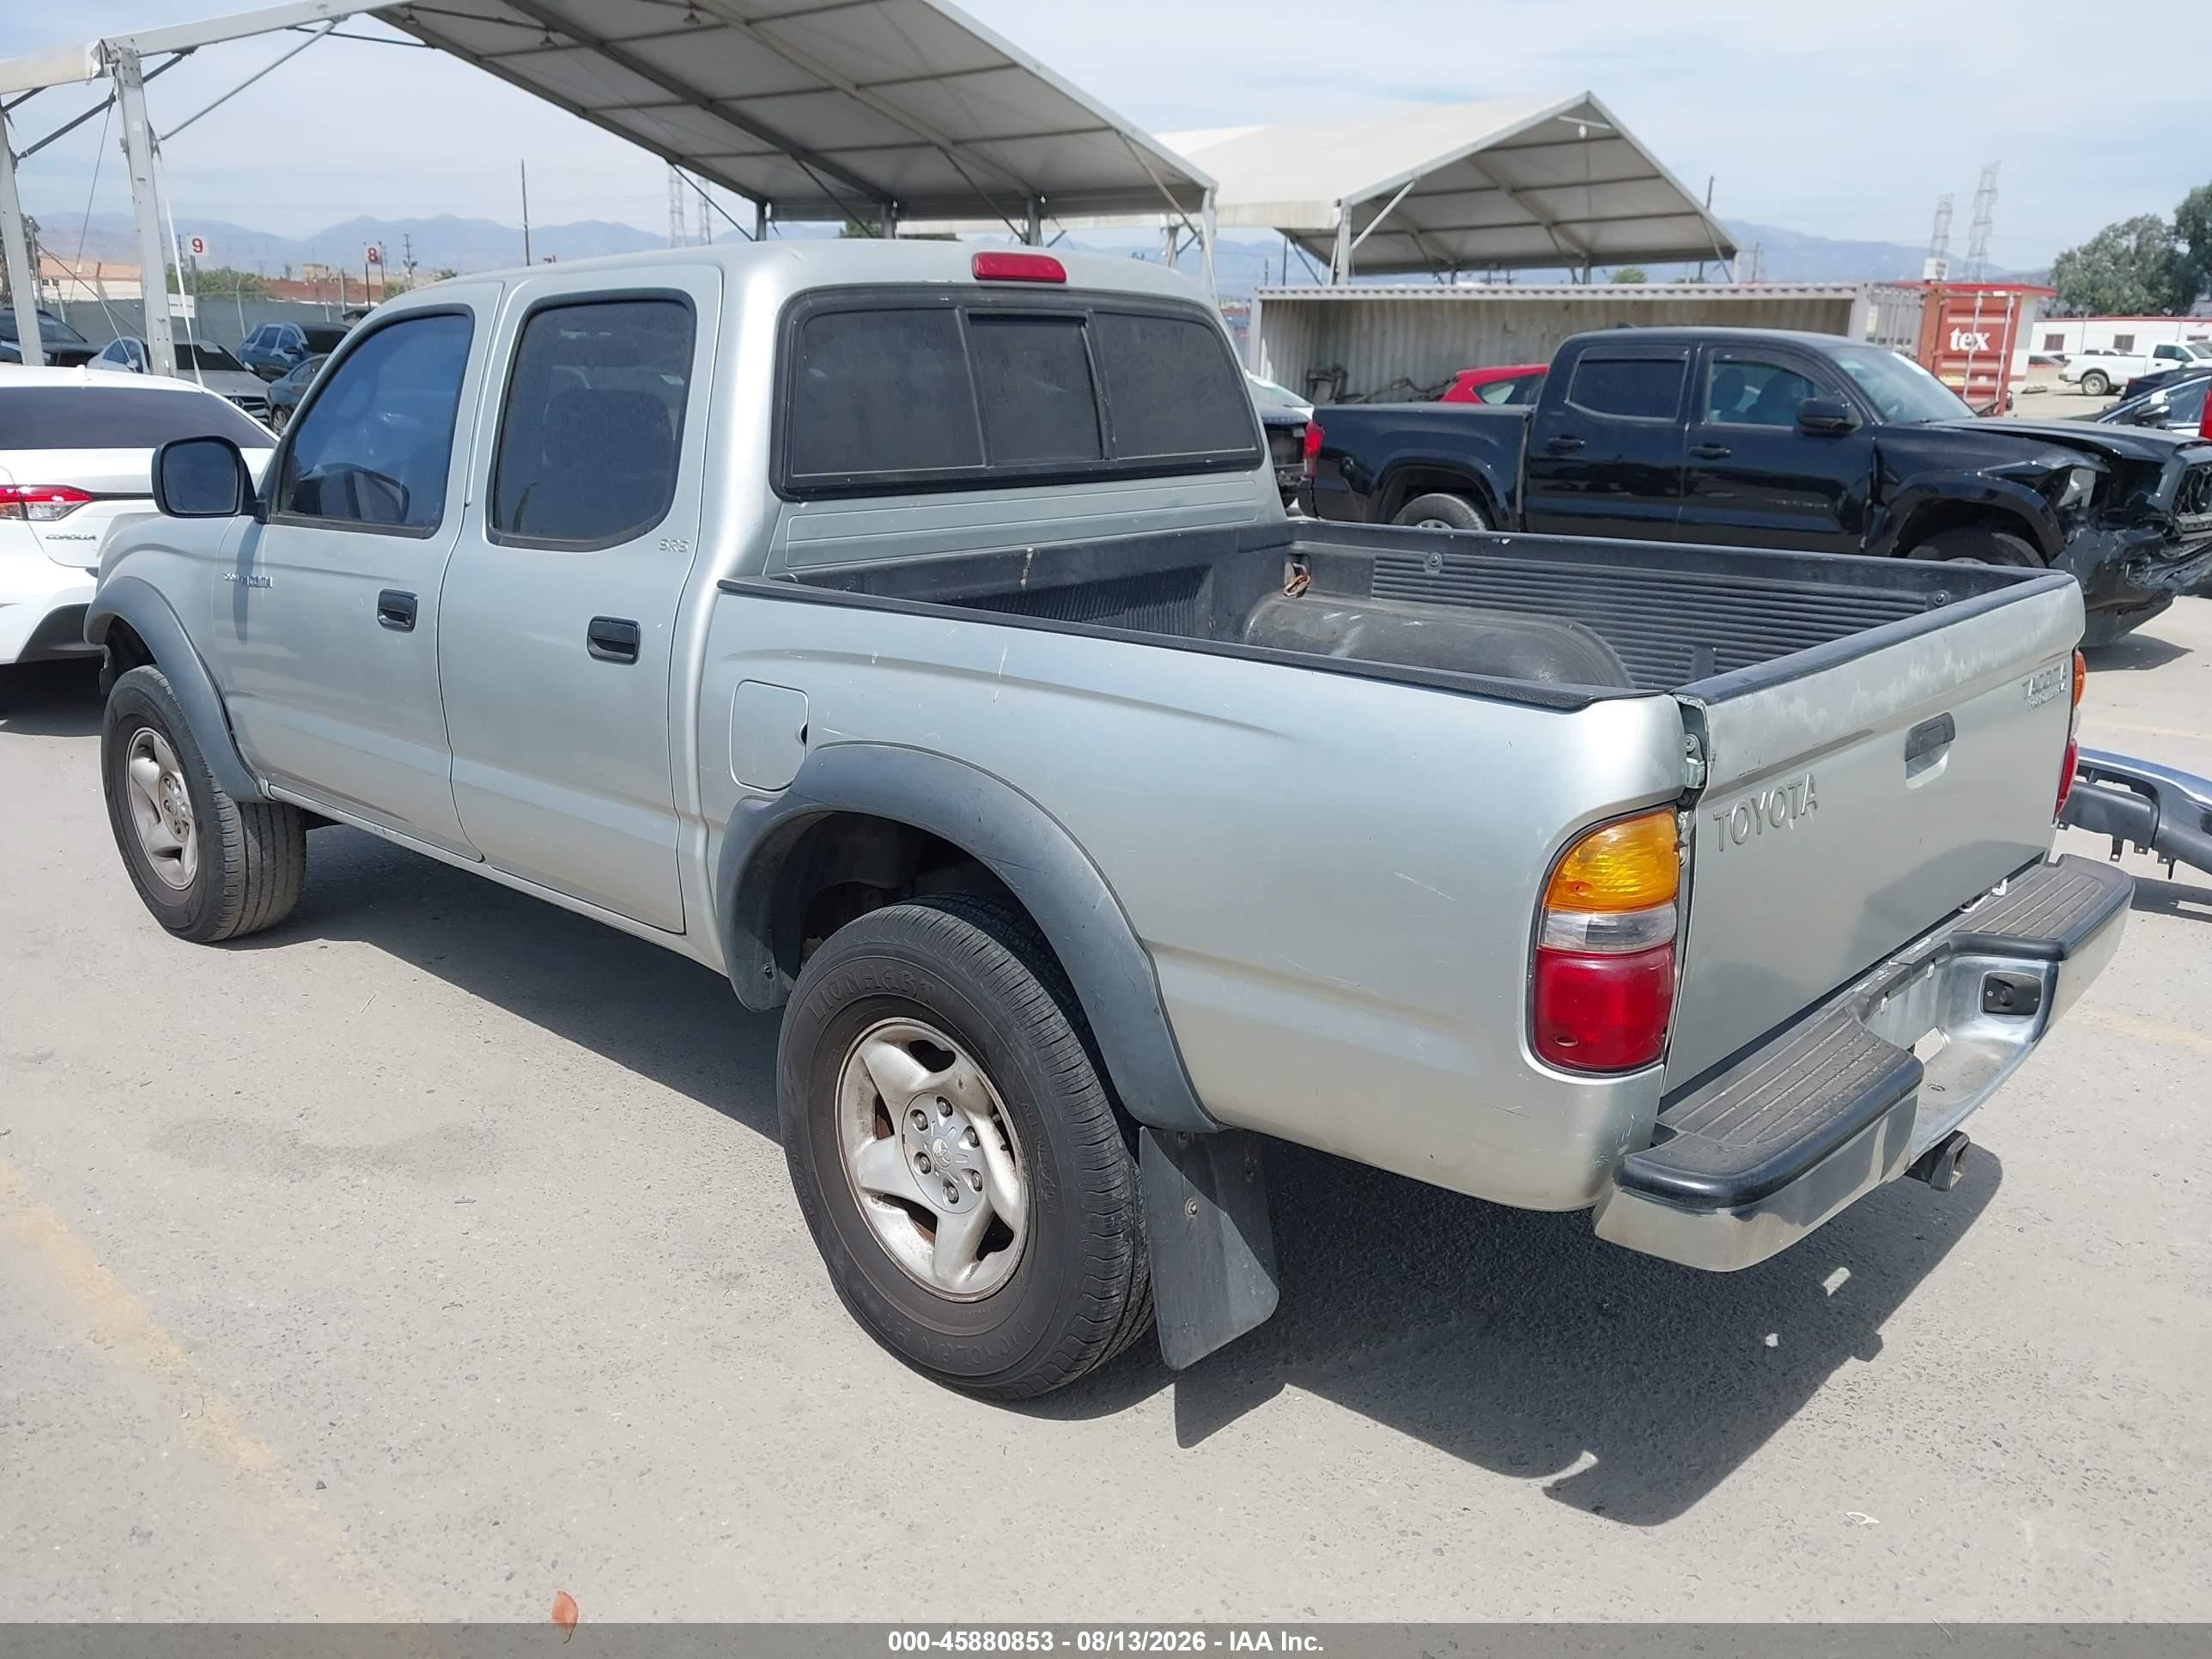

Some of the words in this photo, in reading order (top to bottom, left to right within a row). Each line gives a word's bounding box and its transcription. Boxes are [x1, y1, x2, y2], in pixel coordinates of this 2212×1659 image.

[191, 238, 204, 253] 9
[367, 247, 379, 264] 8
[1949, 326, 1991, 351] tex
[1712, 772, 1819, 853] TOYOTA
